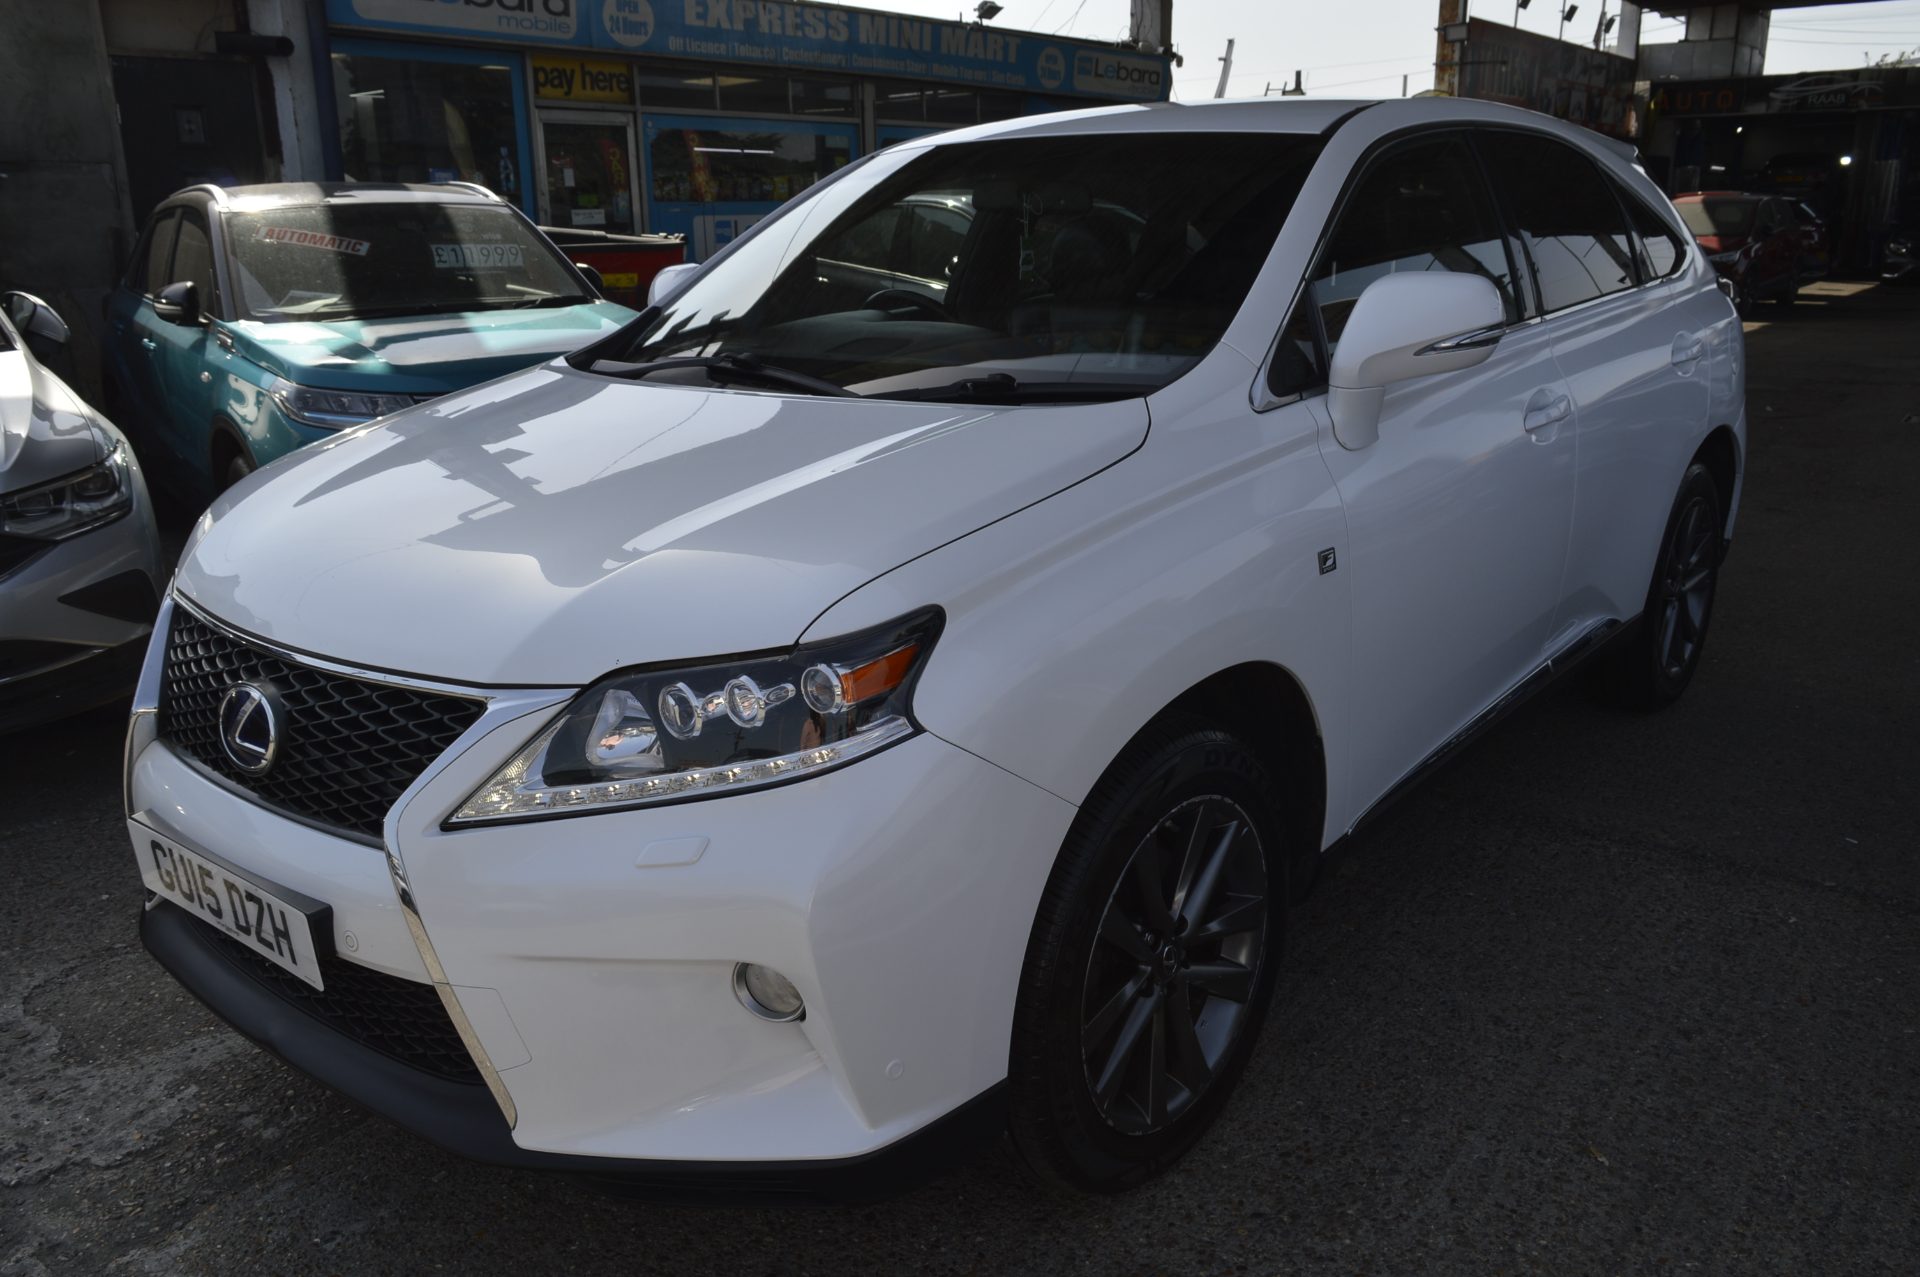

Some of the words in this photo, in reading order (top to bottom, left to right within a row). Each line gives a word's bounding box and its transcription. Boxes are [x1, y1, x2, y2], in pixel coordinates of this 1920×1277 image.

[498, 15, 571, 34] mobile
[609, 15, 621, 34] 24
[684, 0, 849, 42] EXPRESS
[859, 13, 931, 52] MINI
[940, 25, 1020, 64] MART
[686, 37, 725, 56] Licence
[734, 42, 776, 58] Tobacco
[534, 64, 576, 97] pay
[580, 64, 630, 93] here
[1093, 57, 1160, 86] Lebara
[265, 228, 363, 253] AUTOMATIC
[435, 246, 520, 265] £11999
[151, 839, 223, 920] GU15
[223, 878, 298, 967] DZH
